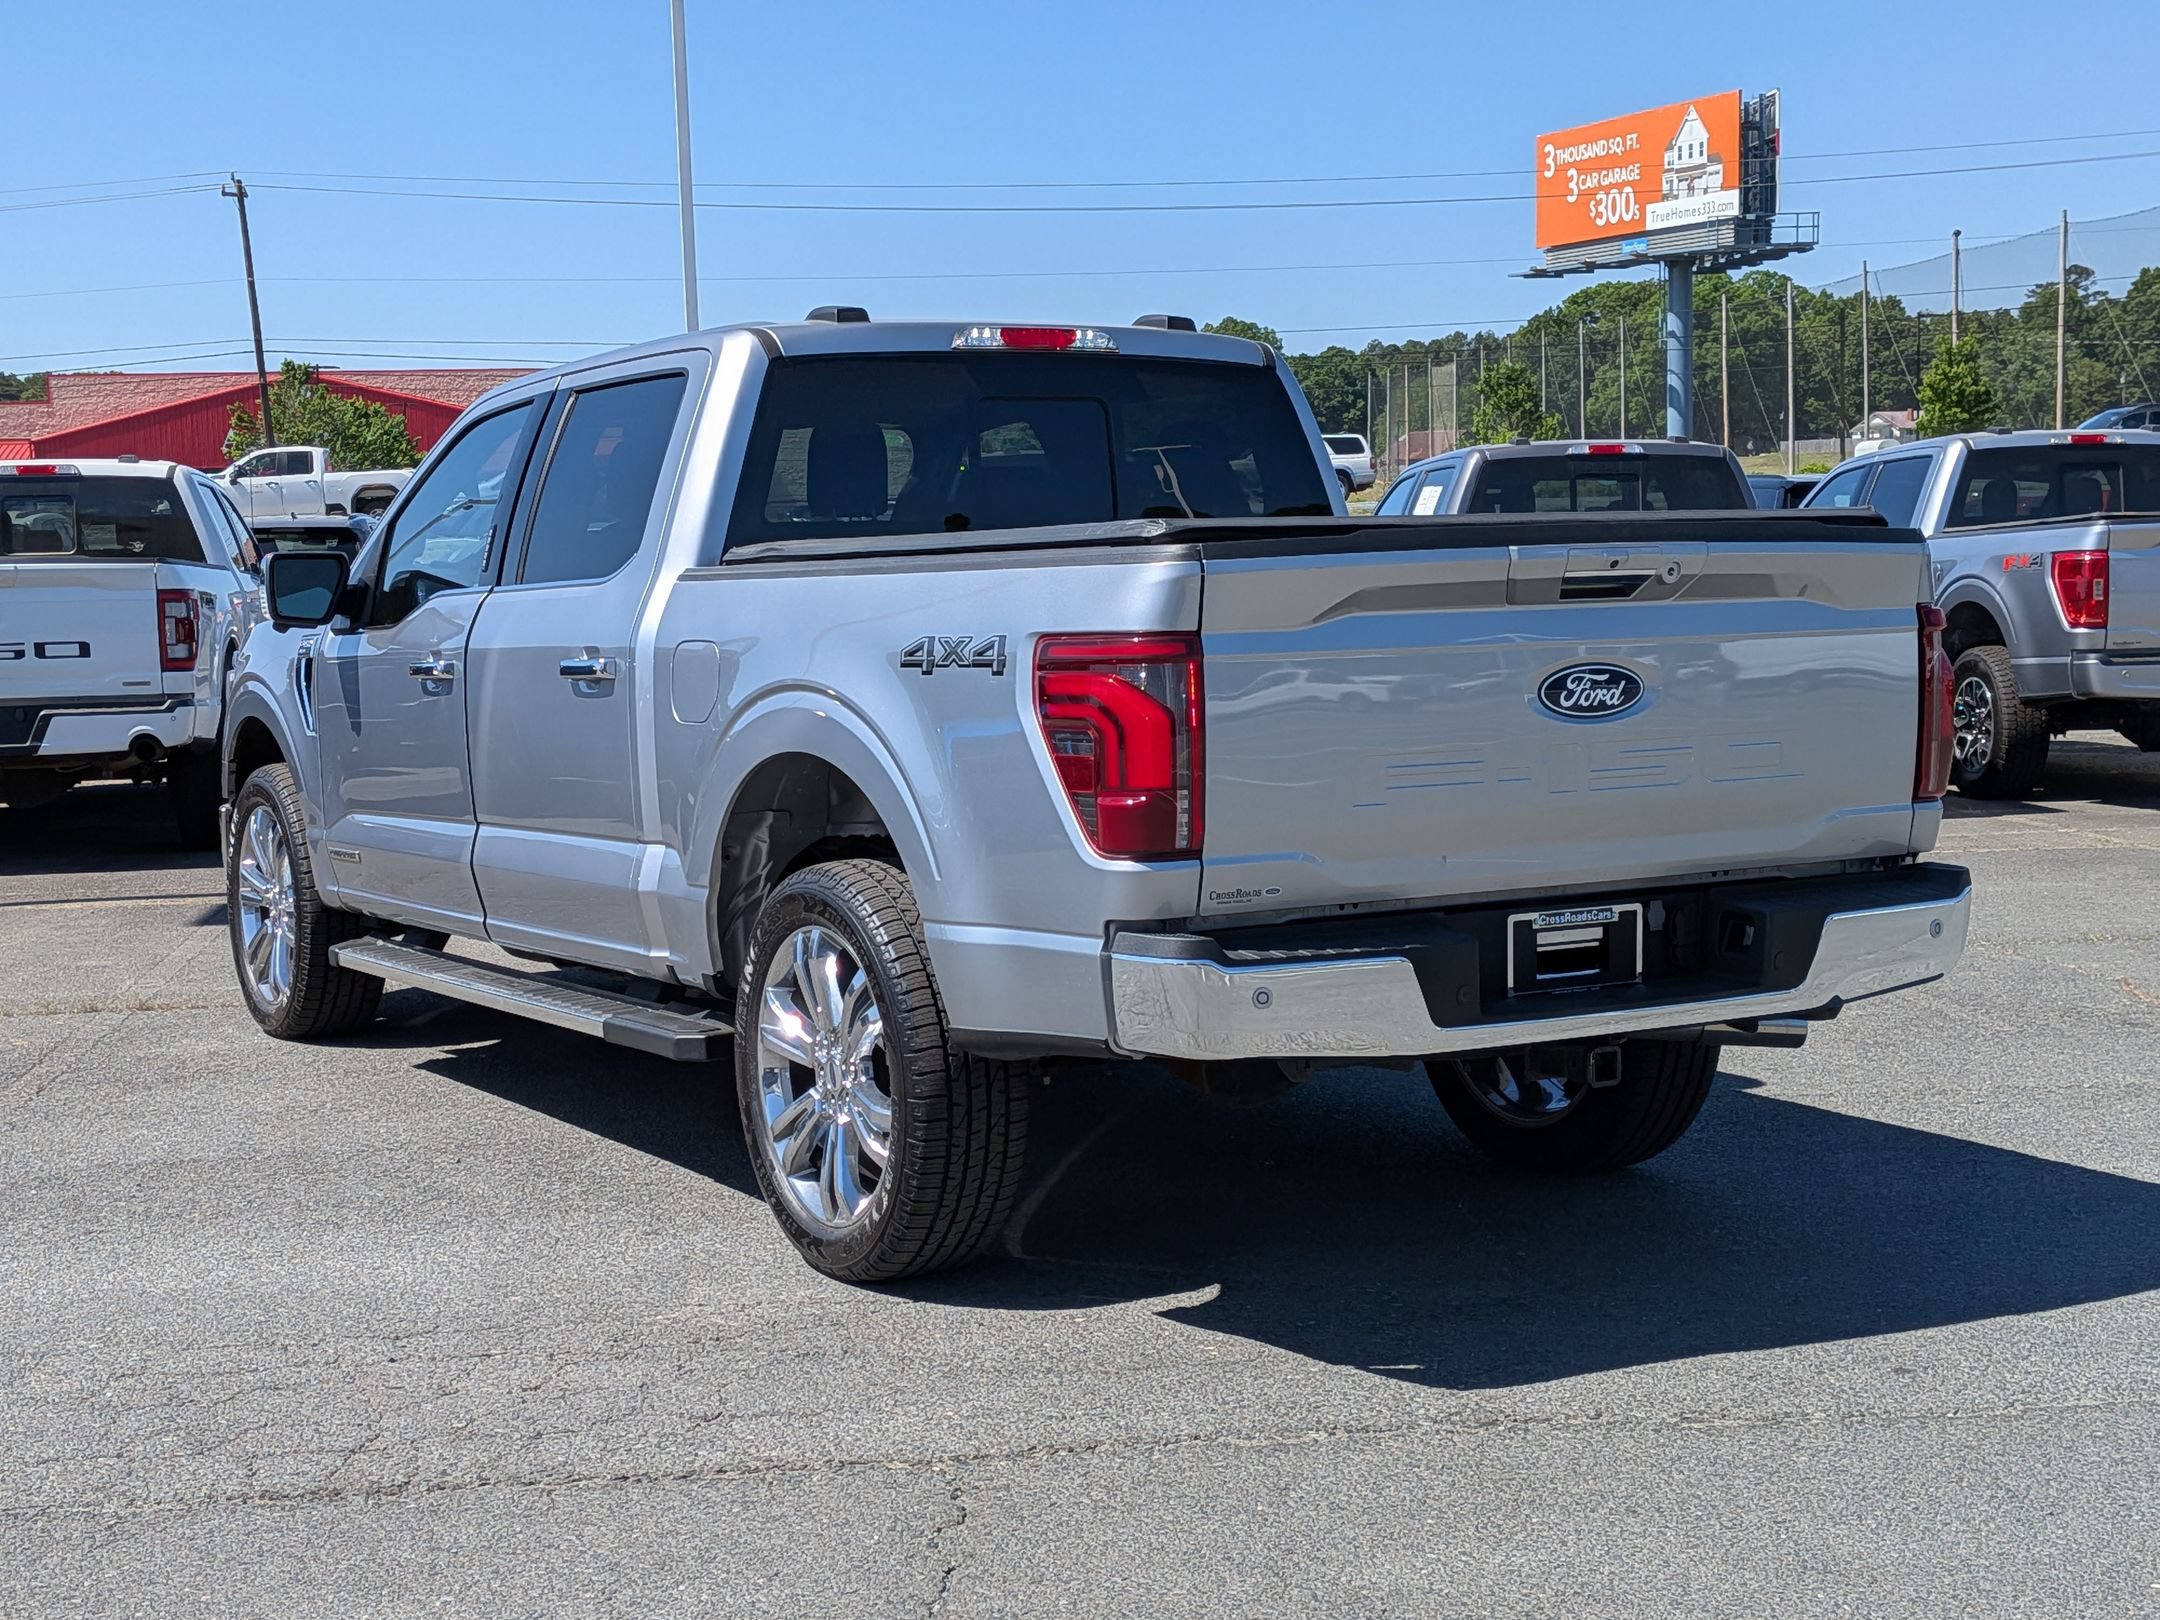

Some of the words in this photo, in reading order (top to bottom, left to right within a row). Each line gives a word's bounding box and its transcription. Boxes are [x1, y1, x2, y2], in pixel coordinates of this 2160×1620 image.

[1543, 143, 1556, 178] 3
[1556, 139, 1608, 165] THOUSAND
[1608, 136, 1625, 156] SQ.
[1626, 133, 1641, 151] FT.
[1567, 167, 1579, 203] 3
[1579, 172, 1600, 190] CAR
[1600, 163, 1641, 186] GARAGE
[1650, 200, 1735, 224] TrueHomes333.com
[2002, 552, 2044, 572] FX4
[1560, 673, 1626, 707] Ford
